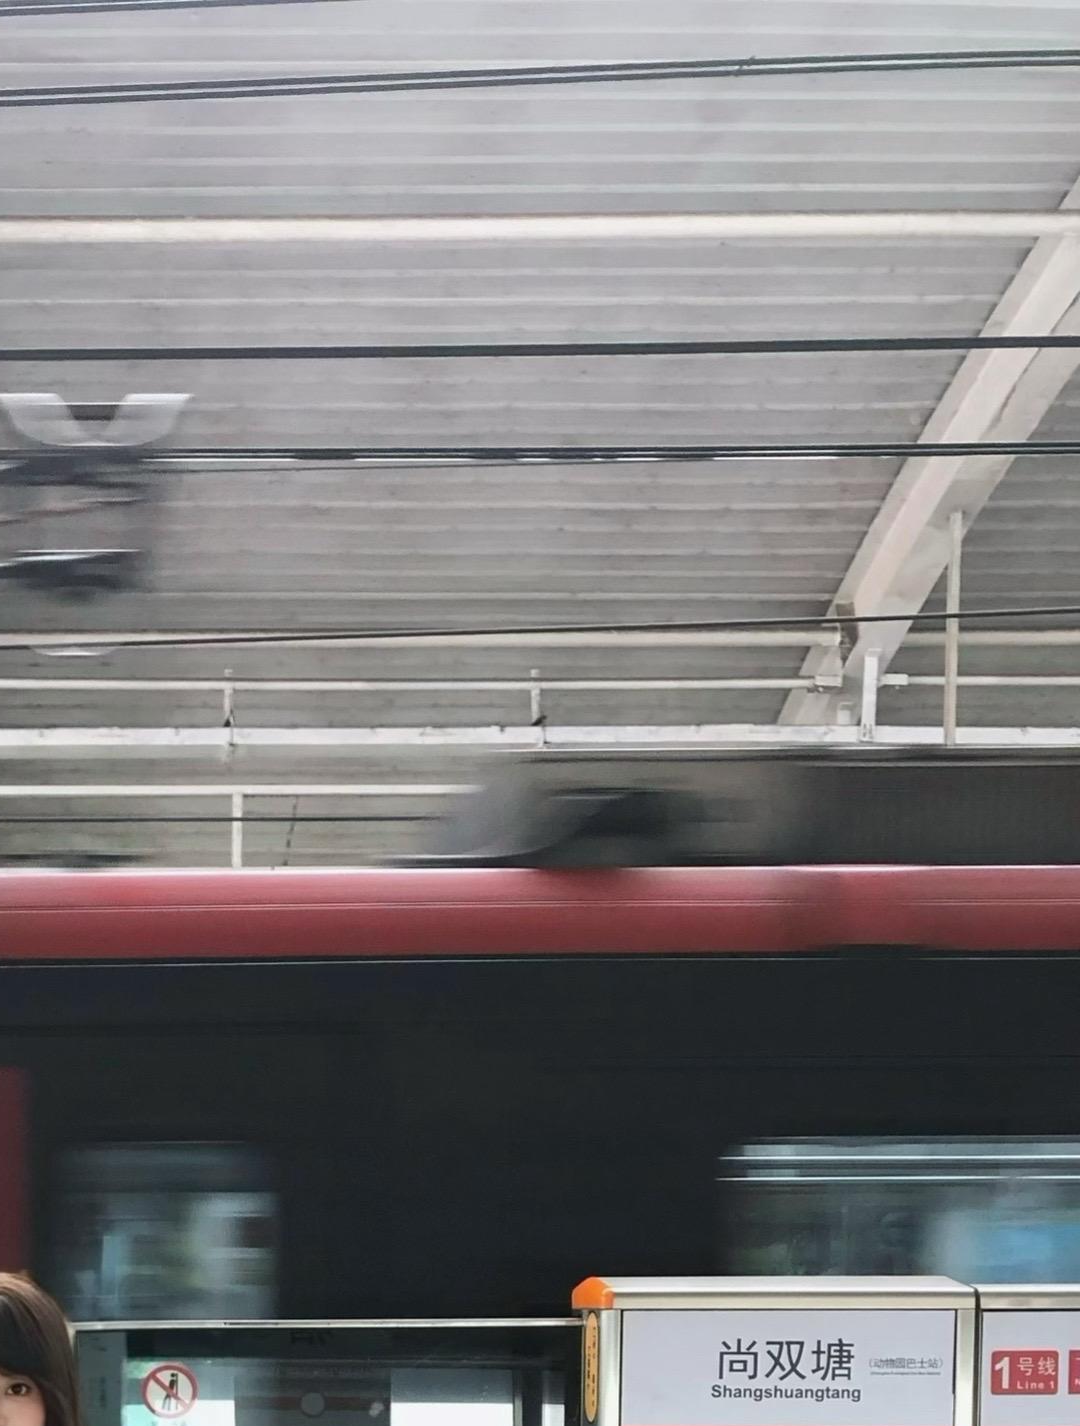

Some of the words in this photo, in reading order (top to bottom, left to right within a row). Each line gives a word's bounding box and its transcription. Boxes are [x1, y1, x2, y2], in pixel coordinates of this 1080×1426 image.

[718, 1338, 855, 1381] 尚双塘
[711, 1384, 862, 1402] Shangshuangtang
[1016, 1380, 1045, 1390] Line
[1049, 1380, 1055, 1390] 1
